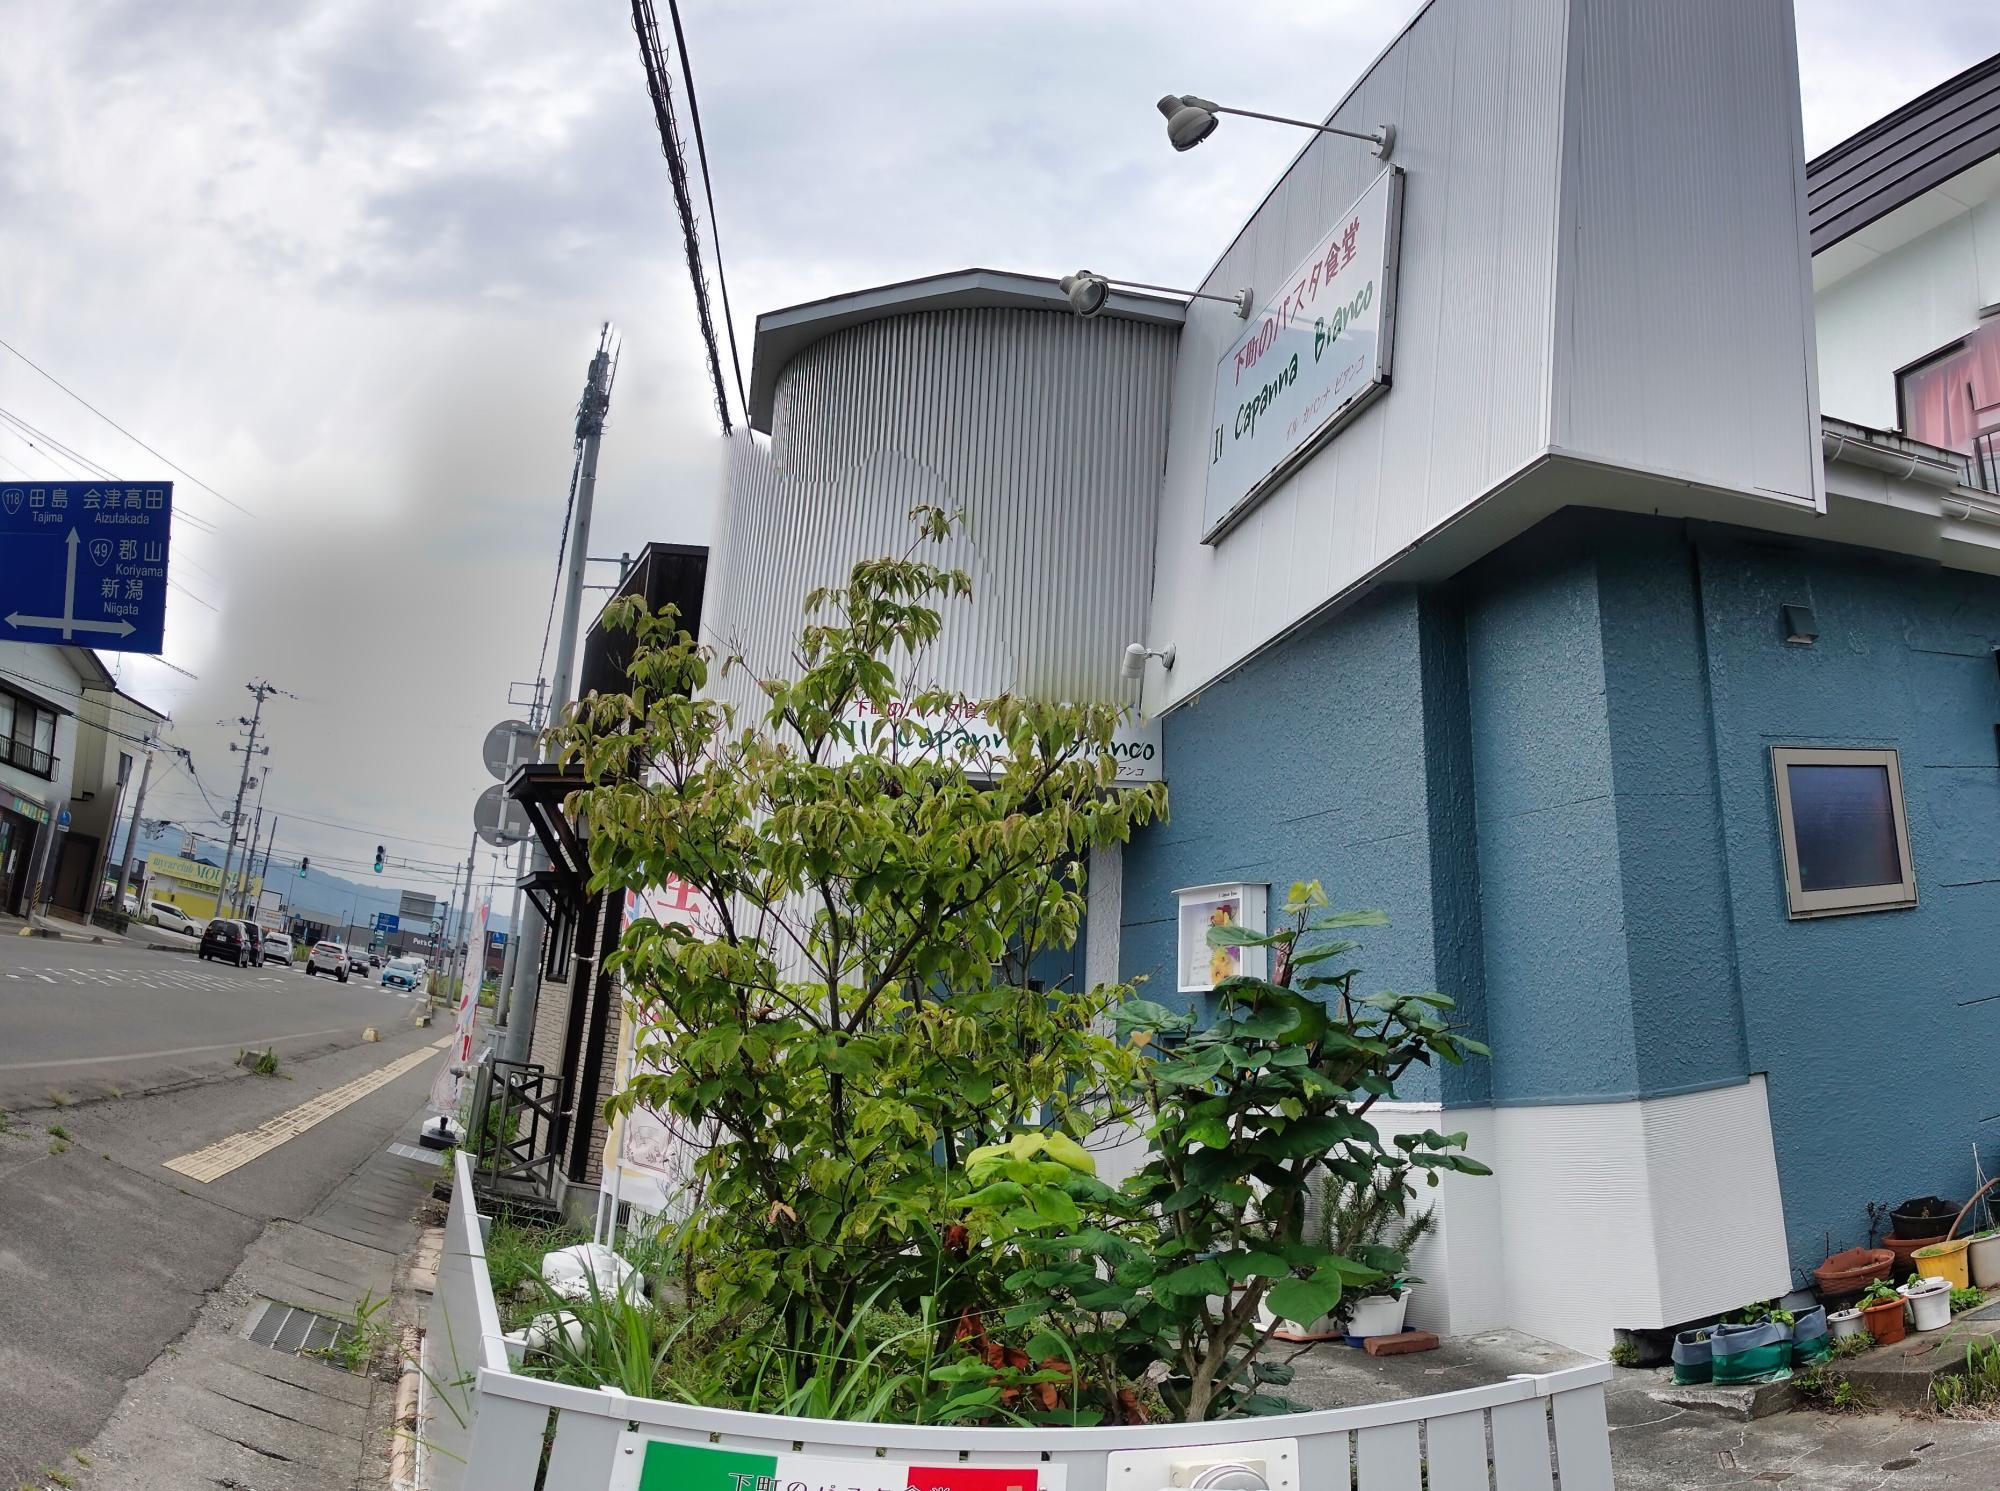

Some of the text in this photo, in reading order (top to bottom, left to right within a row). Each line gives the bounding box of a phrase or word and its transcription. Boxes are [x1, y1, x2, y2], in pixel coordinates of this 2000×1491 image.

[1234, 216, 1360, 387] 下町のパスタ食堂
[1234, 353, 1298, 440] Capanna
[1314, 280, 1373, 364] Bianco
[6, 493, 20, 505] 118
[29, 488, 69, 509] 田島
[83, 488, 163, 510] 会津高田
[32, 511, 63, 525] Tajima
[95, 513, 150, 525] Aizutakada
[93, 543, 108, 558] 49
[118, 539, 162, 562] 郡山
[115, 564, 163, 577] Koriyama
[101, 578, 144, 601] 新潟
[103, 601, 139, 616] Niigata
